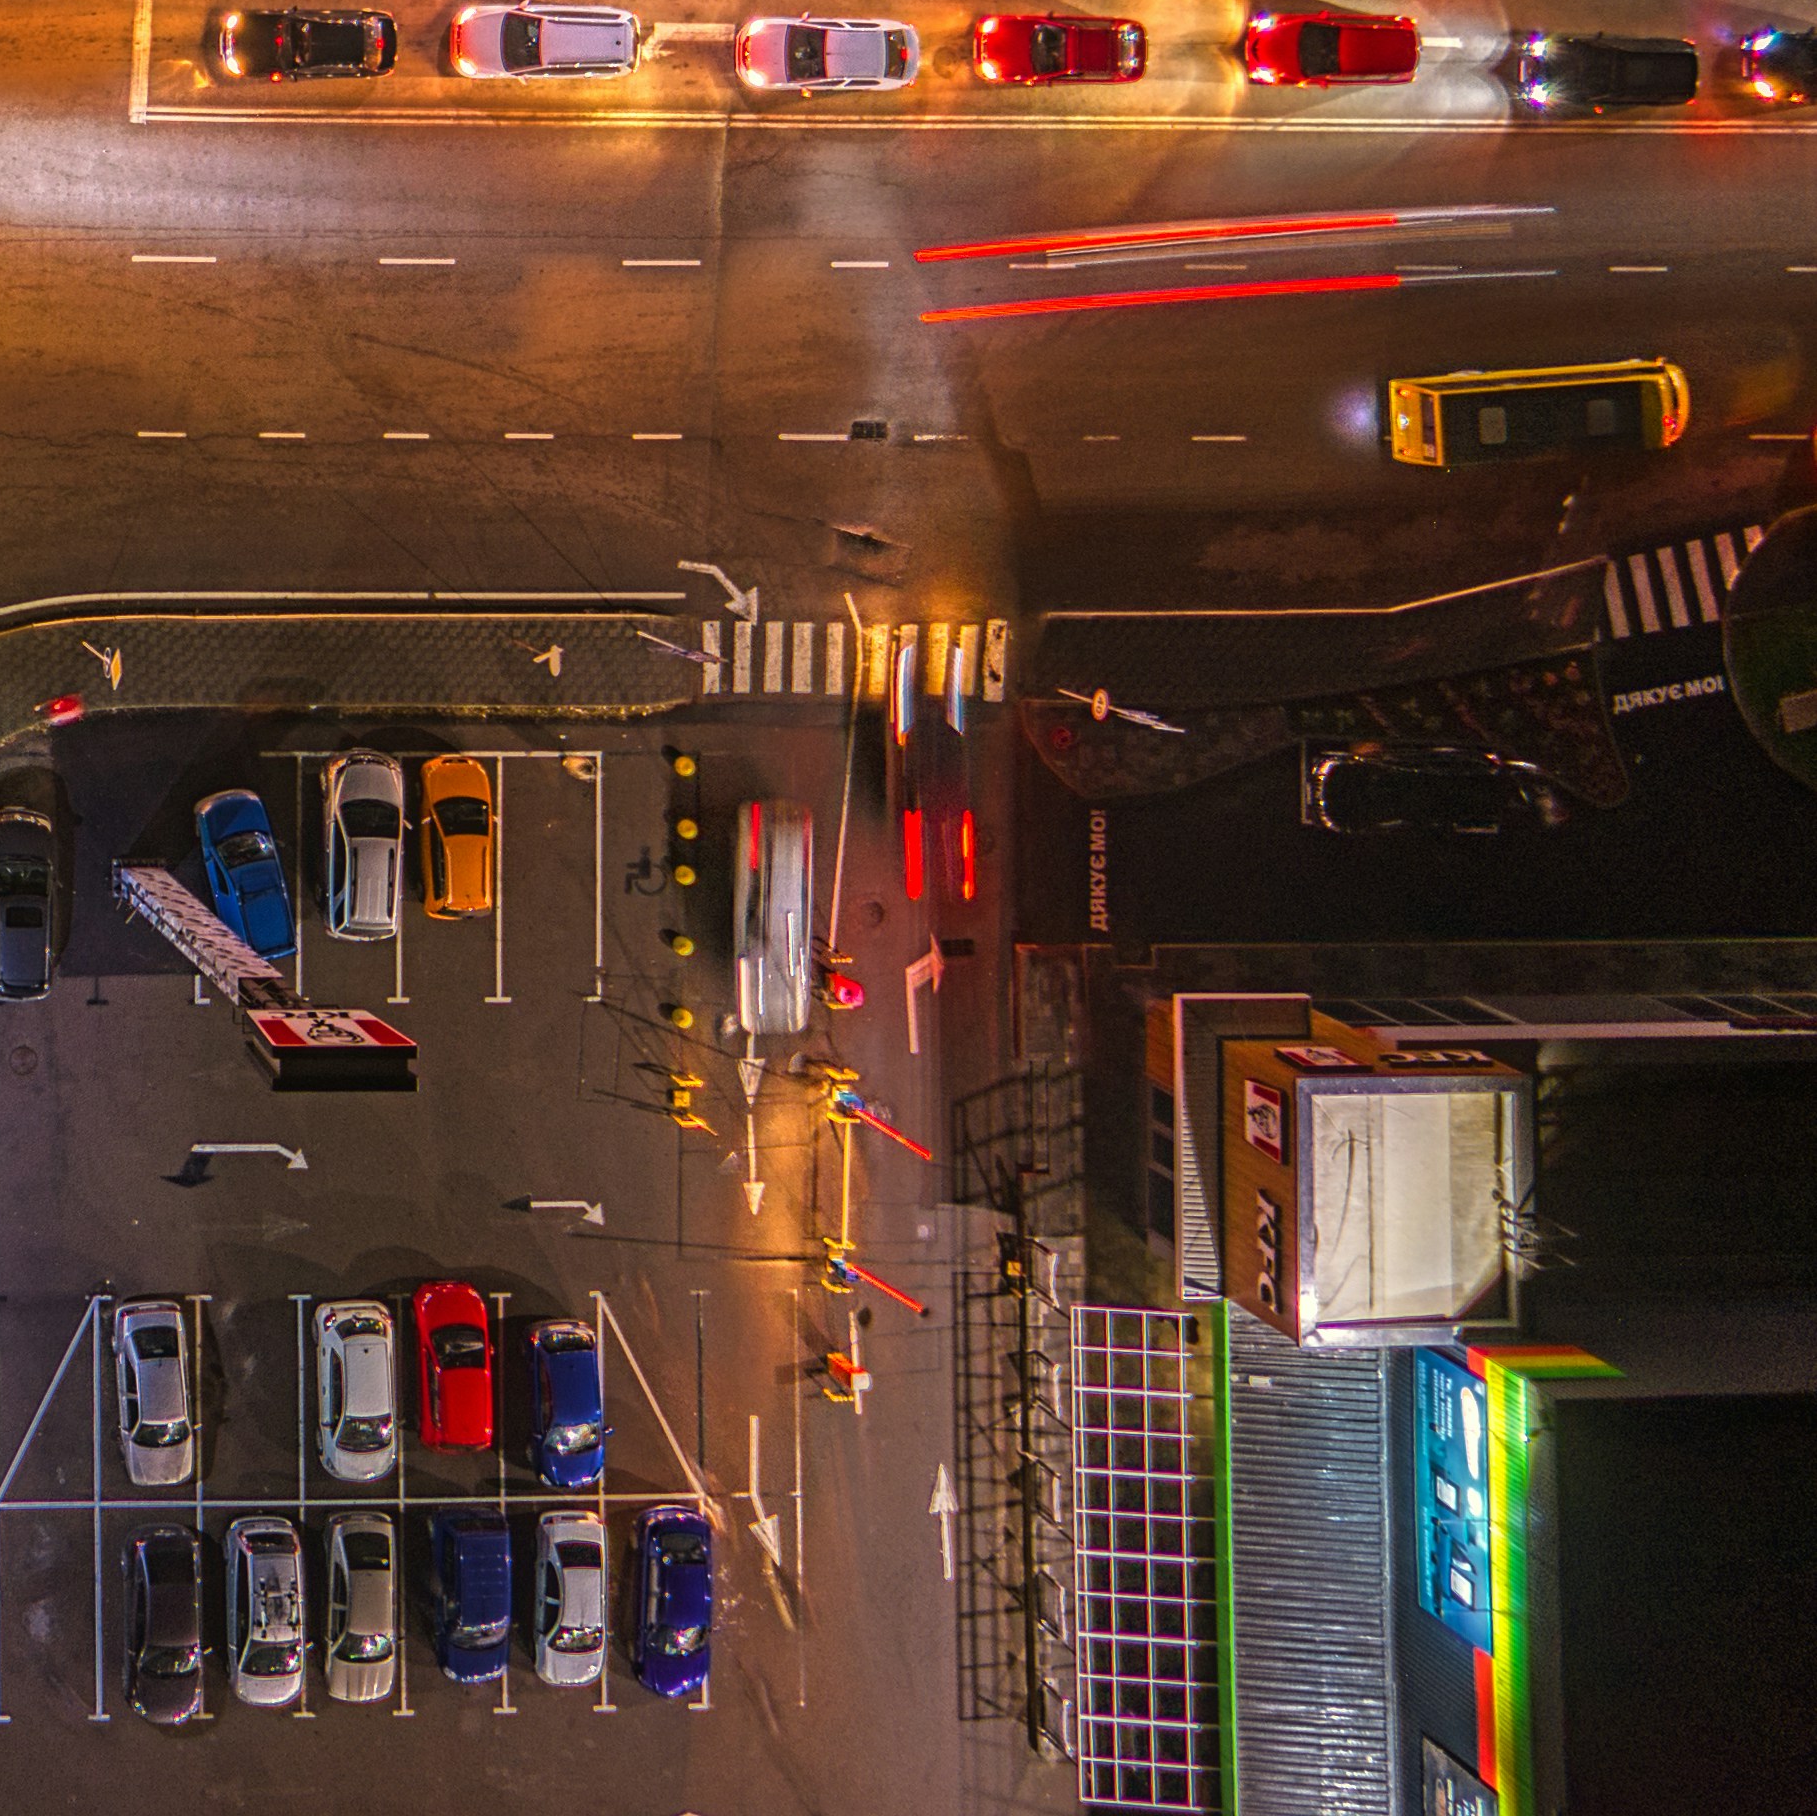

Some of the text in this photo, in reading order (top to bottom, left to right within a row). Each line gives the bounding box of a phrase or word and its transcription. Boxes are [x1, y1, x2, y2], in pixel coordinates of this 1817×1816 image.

[1613, 674, 1725, 716] ДЯКУЄМО!
[1089, 809, 1109, 933] ДЯКУЄМО!
[269, 1011, 351, 1019] KFC
[1379, 1049, 1493, 1065] KFC
[1256, 1189, 1282, 1315] KFC
